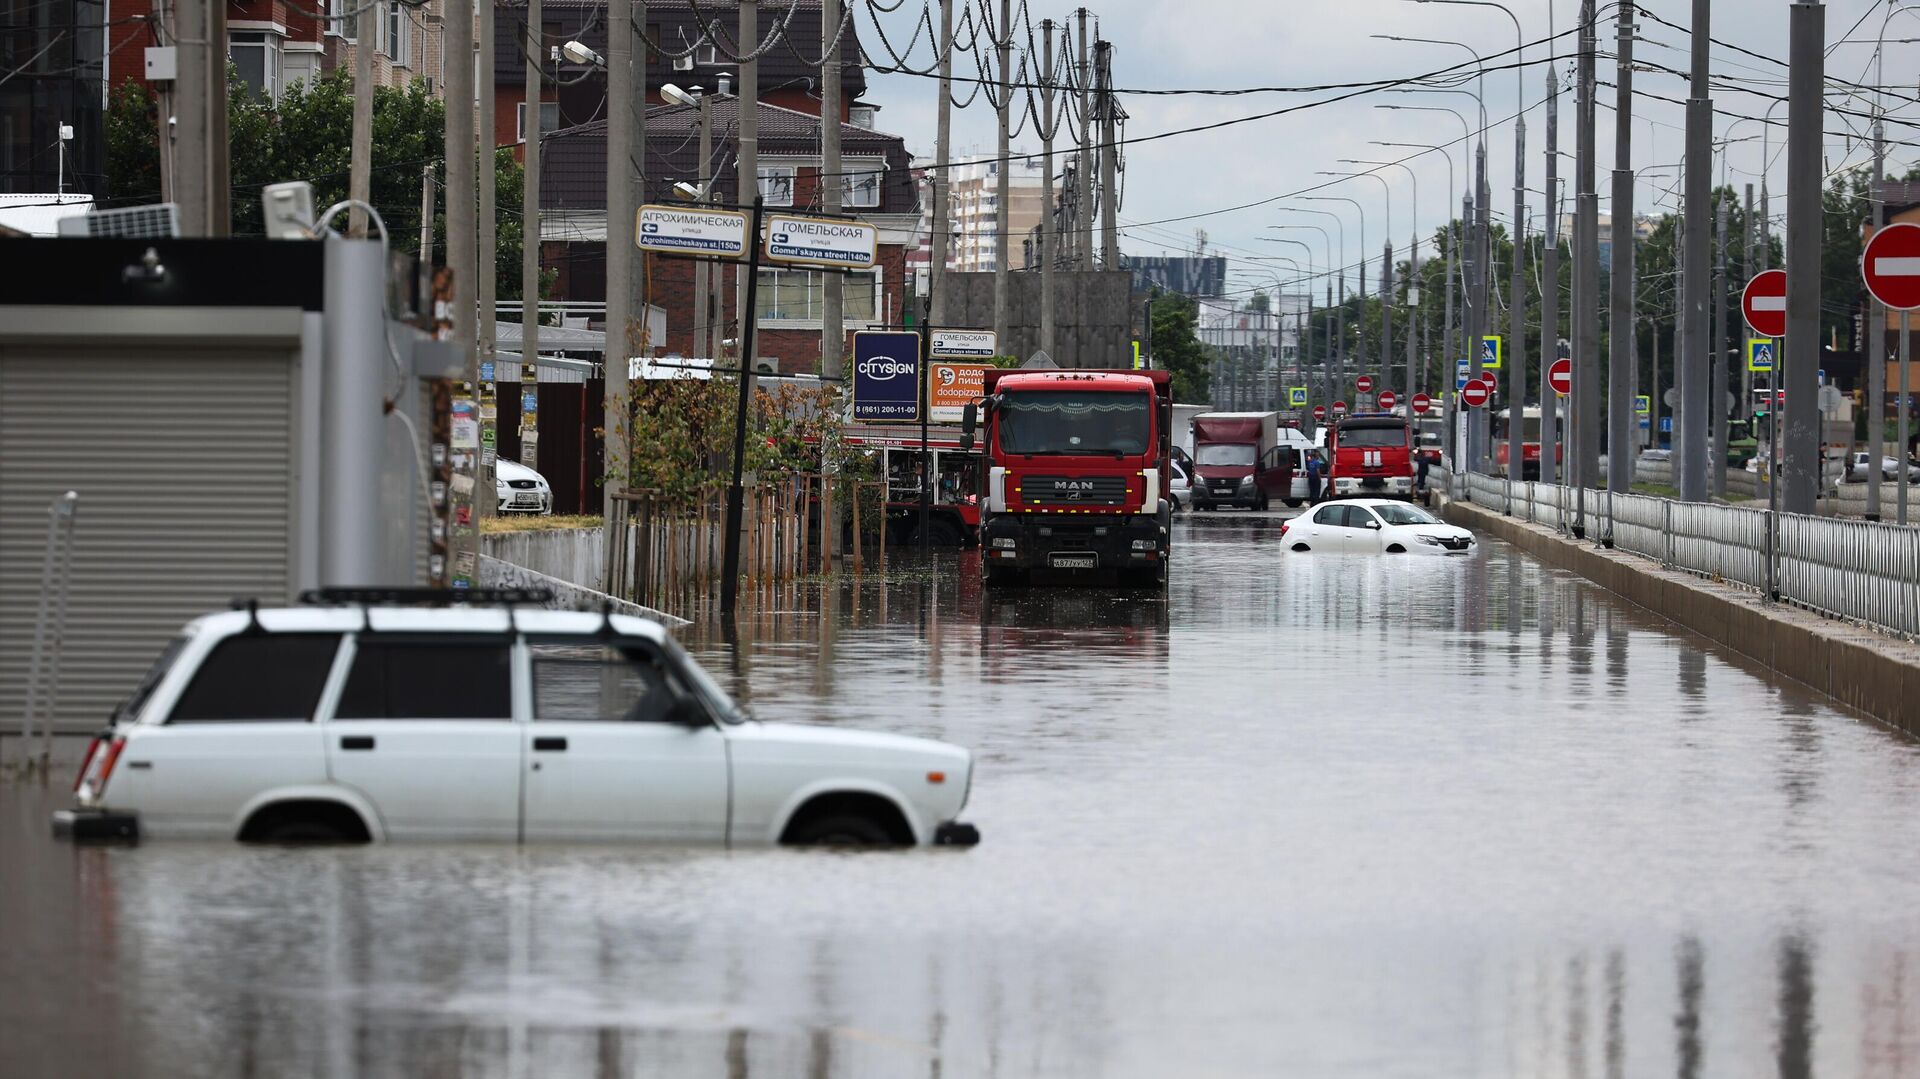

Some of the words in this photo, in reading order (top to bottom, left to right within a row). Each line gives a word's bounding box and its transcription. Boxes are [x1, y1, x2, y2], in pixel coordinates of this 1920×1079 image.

[642, 212, 743, 228] АГРОХИМИЧЕСКАЯ
[682, 227, 702, 235] улица
[782, 222, 863, 238] ГОМЕЛЬСКАЯ
[642, 236, 708, 249] Agrohimicheskaya
[811, 238, 831, 246] улица
[824, 250, 848, 260] street
[858, 362, 914, 374] CITYSIGN
